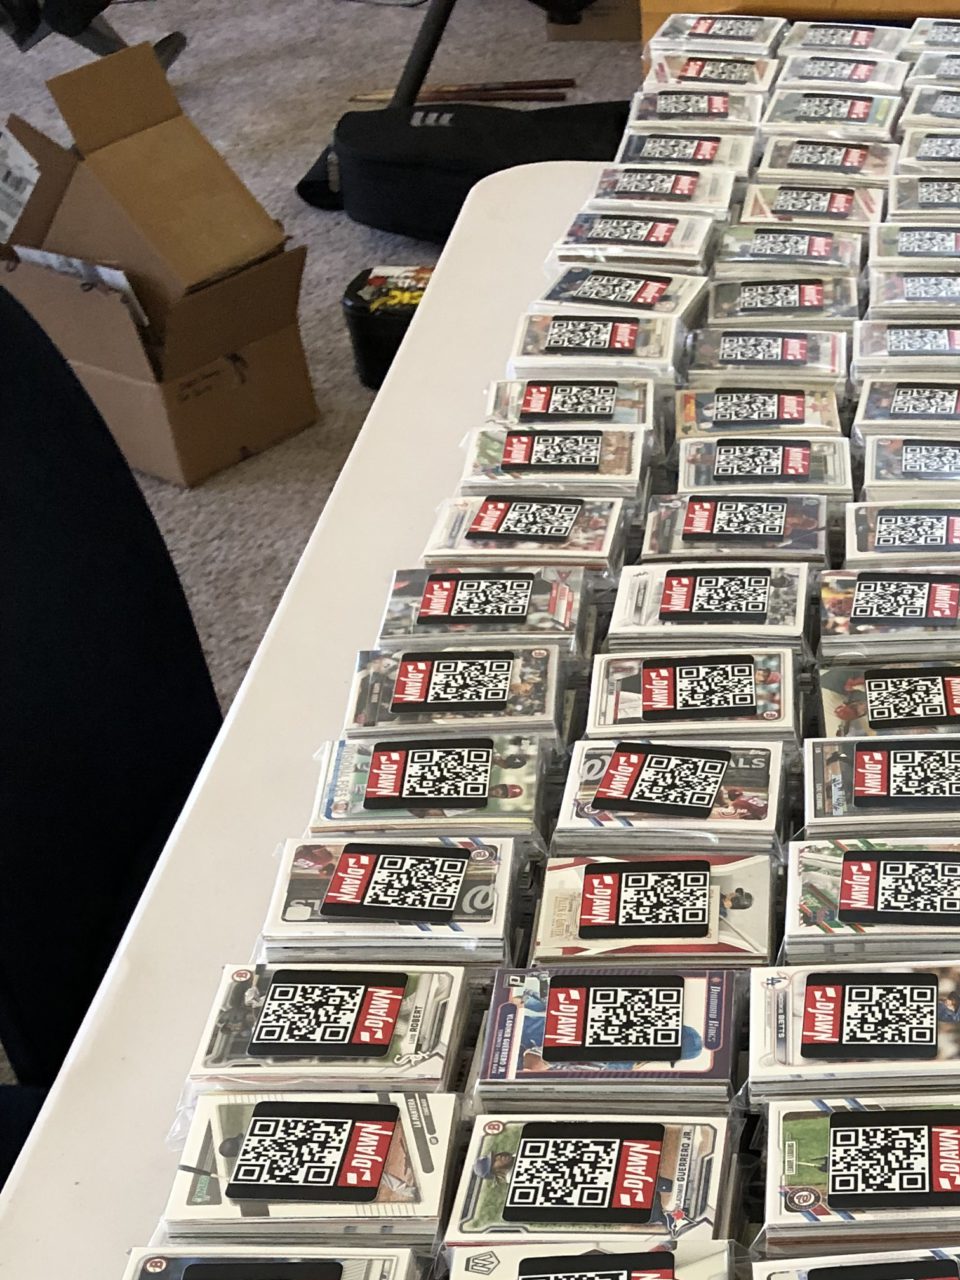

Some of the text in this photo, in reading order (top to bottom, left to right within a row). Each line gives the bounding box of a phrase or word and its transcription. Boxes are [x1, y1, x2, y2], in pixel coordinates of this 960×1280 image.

[409, 1006, 422, 1032] ROBERT
[778, 1014, 786, 1038] BETTS
[676, 1142, 691, 1182] GUERRERO
